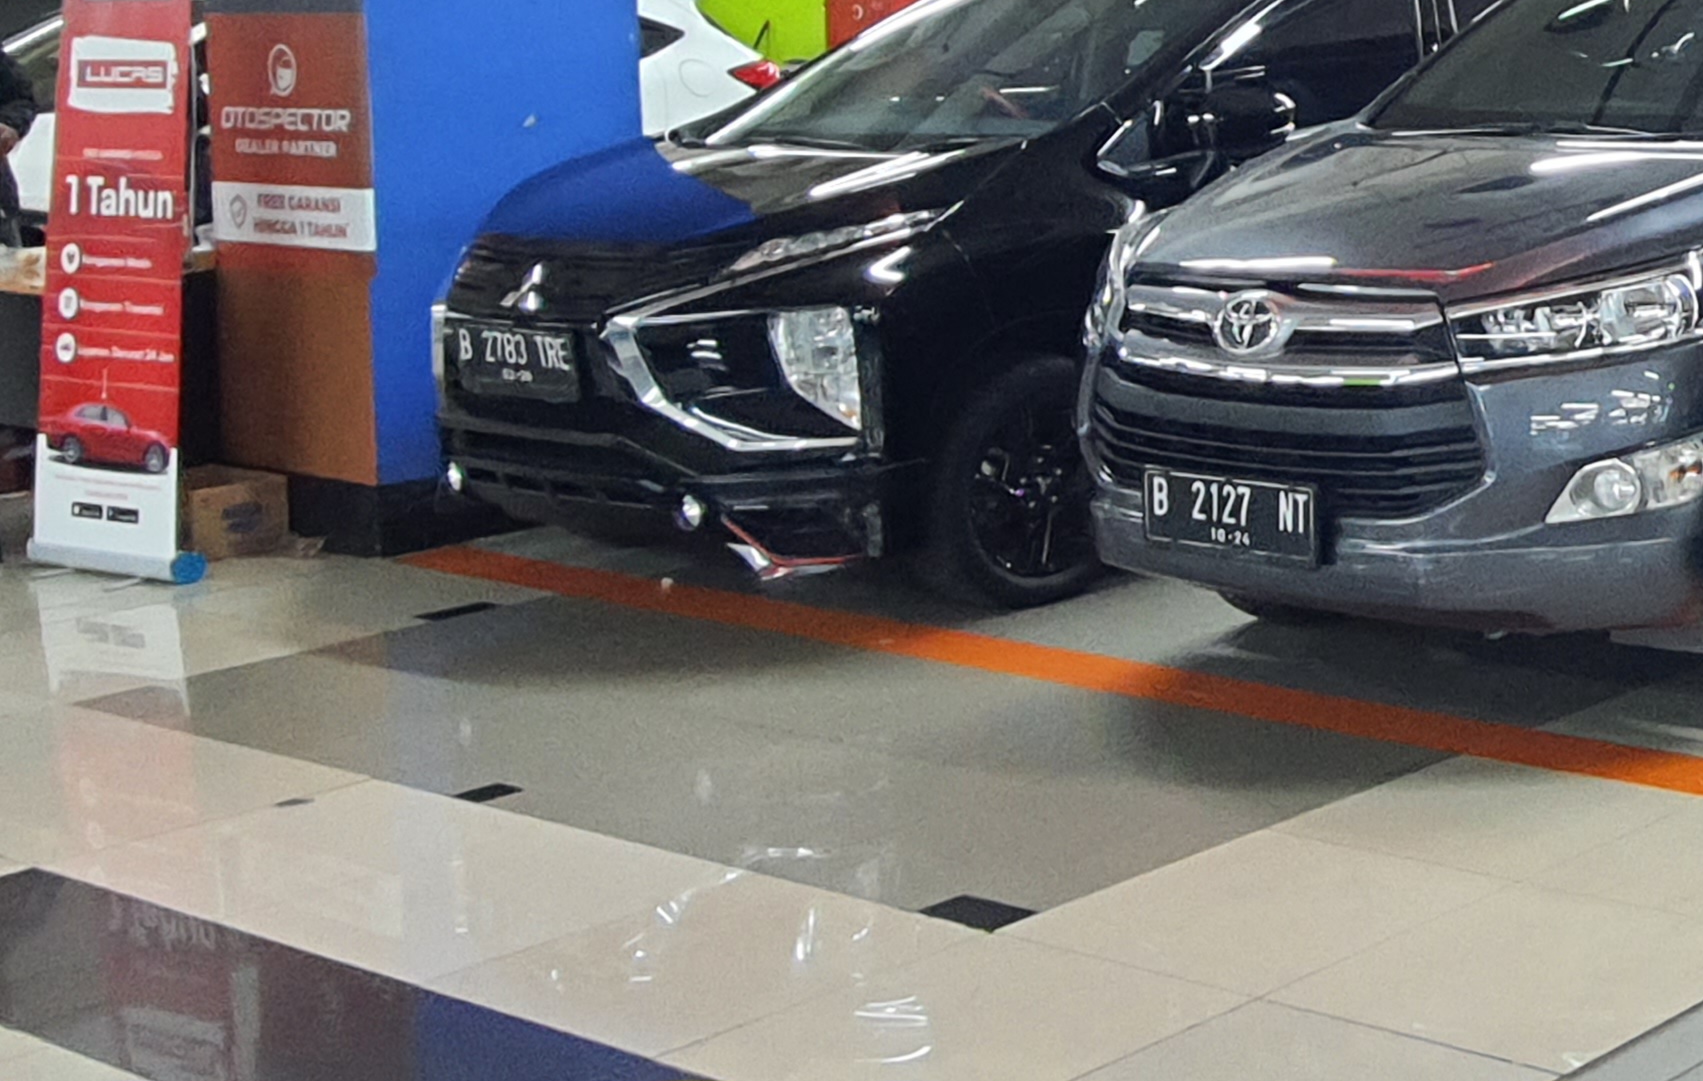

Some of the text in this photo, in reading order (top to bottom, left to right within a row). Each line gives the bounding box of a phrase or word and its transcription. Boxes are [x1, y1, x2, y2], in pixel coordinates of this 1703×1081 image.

[84, 65, 165, 84] LUCAS
[221, 106, 351, 132] OTOSPECTOR
[65, 175, 174, 220] 1 Tahun
[458, 328, 473, 361] B
[533, 335, 571, 371] TRE
[1153, 475, 1309, 534] B 2127 NT
